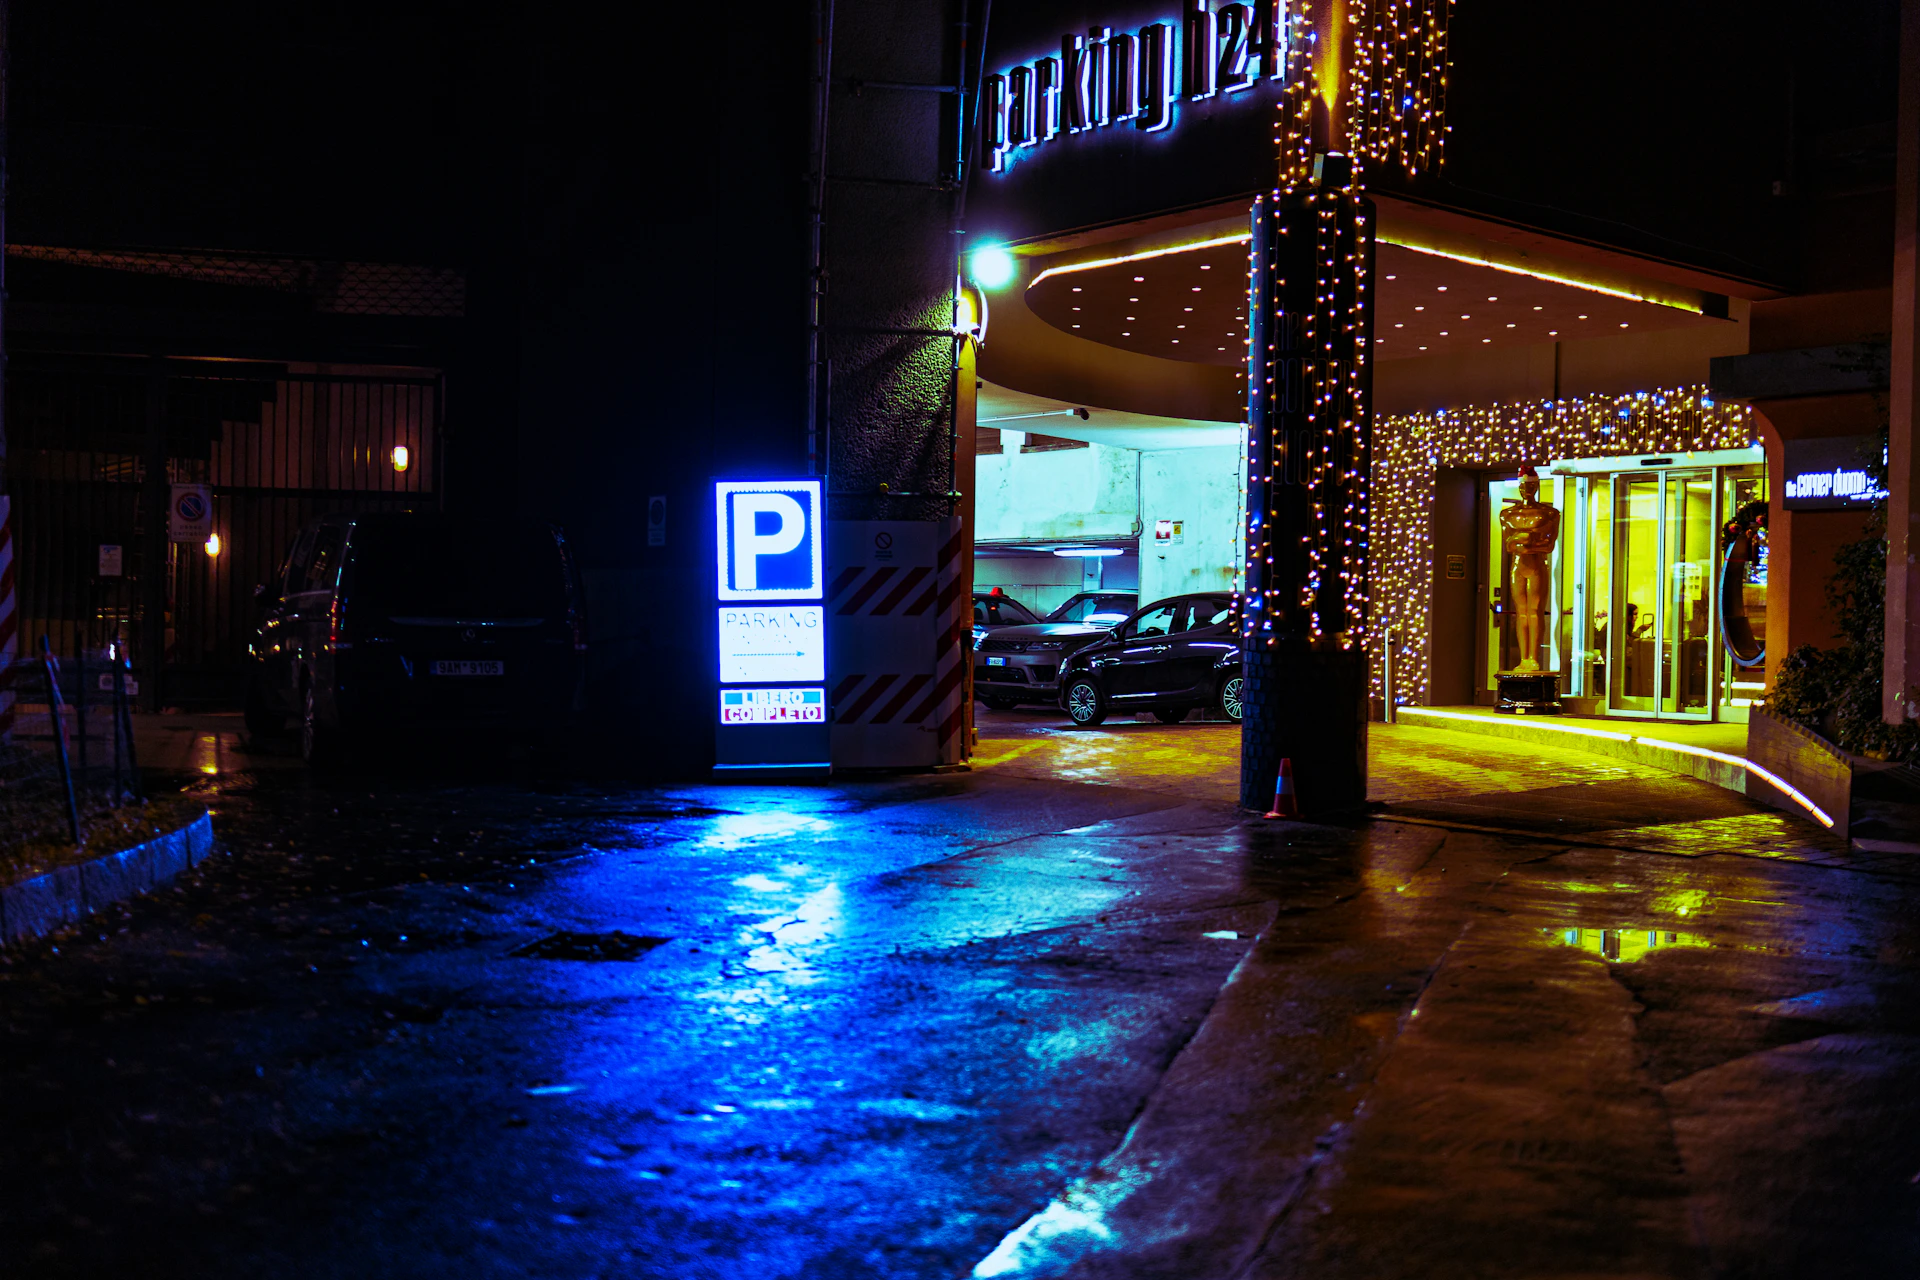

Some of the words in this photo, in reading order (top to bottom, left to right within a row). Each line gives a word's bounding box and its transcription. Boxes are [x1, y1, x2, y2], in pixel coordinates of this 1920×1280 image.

[982, 23, 1174, 172] parking
[1797, 472, 1832, 498] corner
[733, 493, 806, 591] P
[726, 611, 817, 628] PARKING
[469, 661, 498, 674] 9105
[742, 691, 805, 705] LIBERO
[728, 706, 819, 721] COMPLETO
